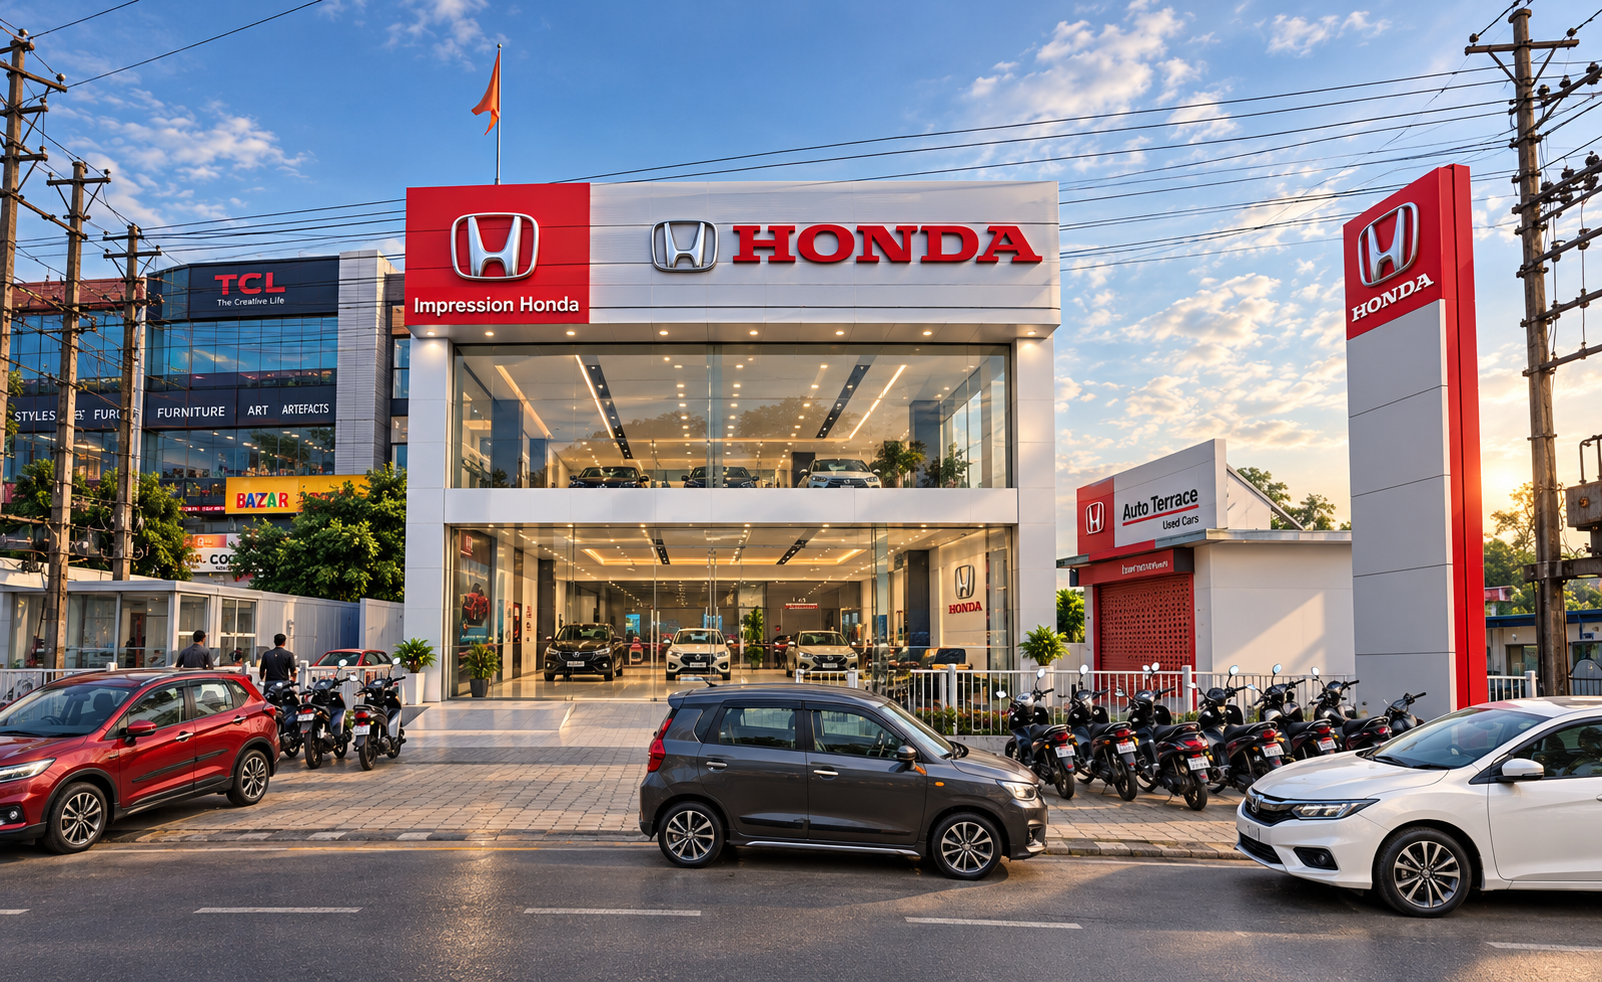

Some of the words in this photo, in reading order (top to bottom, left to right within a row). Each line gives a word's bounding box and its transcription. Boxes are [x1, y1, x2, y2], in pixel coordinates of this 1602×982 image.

[733, 224, 1043, 265] HONDA
[214, 272, 286, 295] TCL
[217, 299, 232, 307] The
[234, 297, 268, 306] Creative
[270, 296, 285, 305] Life
[413, 296, 514, 316] Impression
[519, 295, 579, 313] Honda
[1351, 272, 1434, 323] HONDA
[14, 410, 56, 422] STYLES
[157, 406, 225, 418] FURNITURE
[247, 405, 269, 416] ART
[282, 403, 329, 415] ARTEFACTS
[236, 492, 289, 508] BAZAR
[1122, 502, 1149, 520] Auto
[1150, 488, 1199, 513] Terrace
[1162, 517, 1180, 530] Used
[1181, 514, 1199, 527] Cars
[948, 601, 982, 615] HONDA
